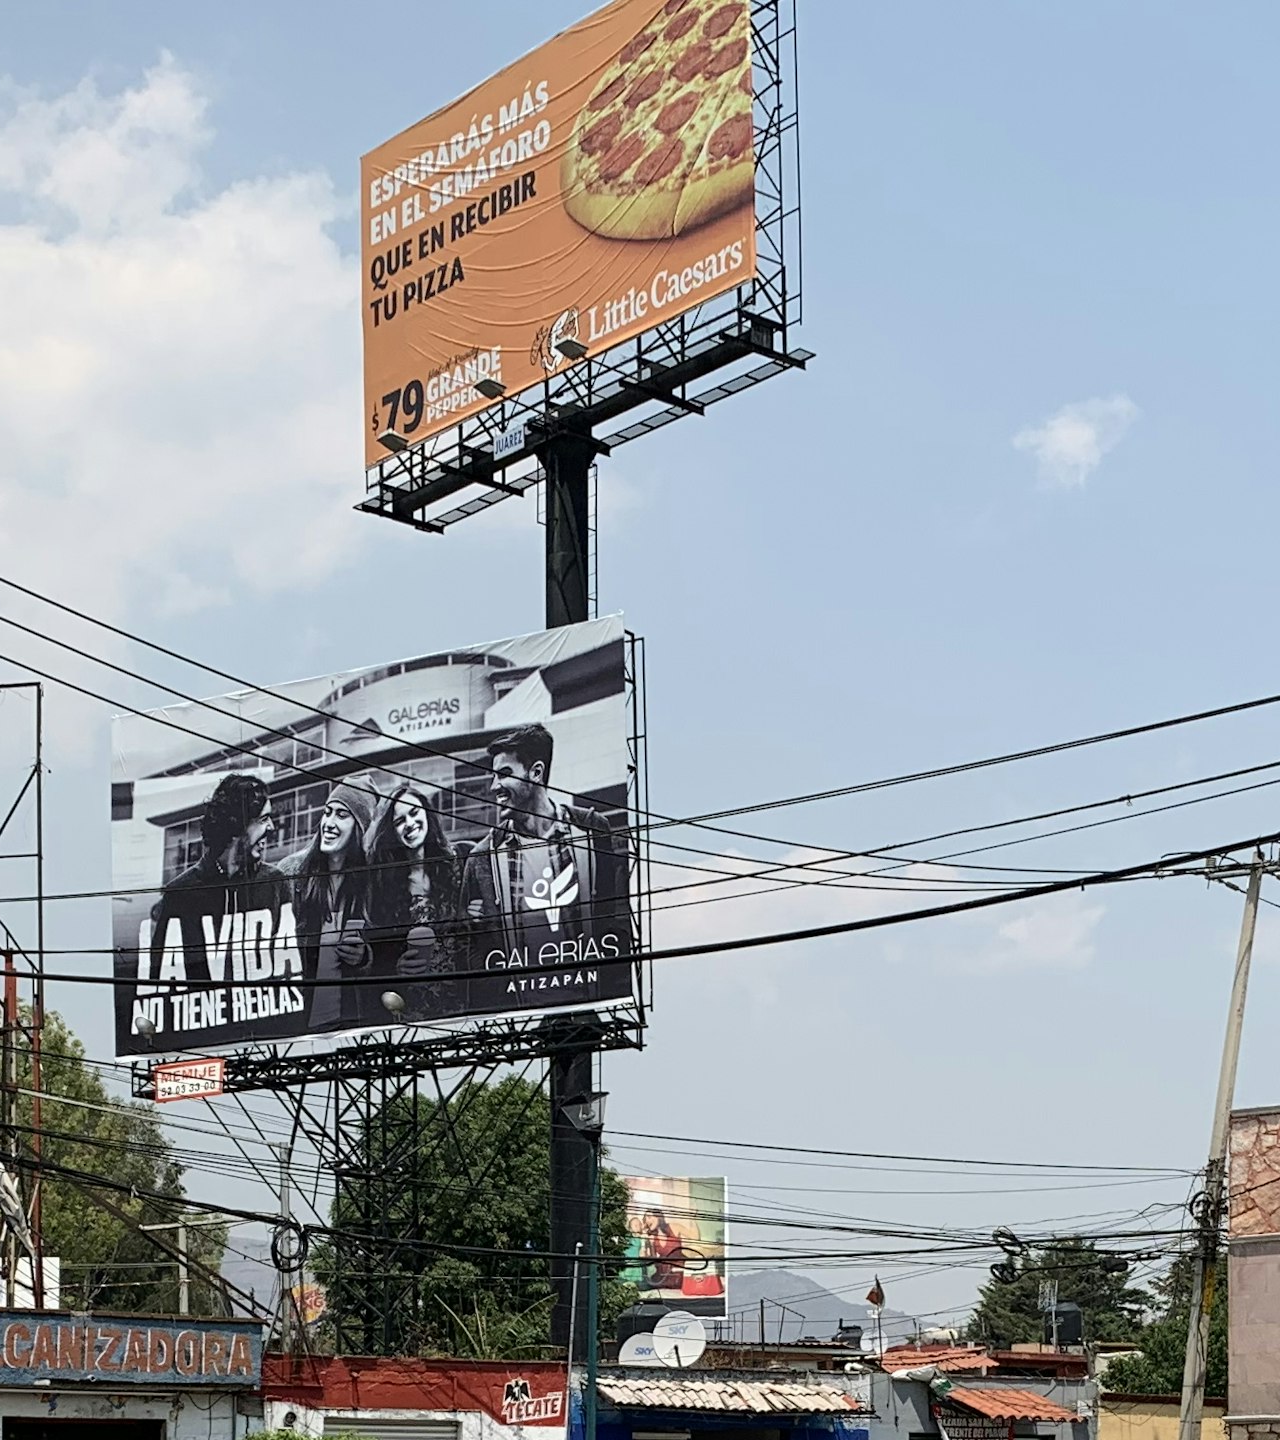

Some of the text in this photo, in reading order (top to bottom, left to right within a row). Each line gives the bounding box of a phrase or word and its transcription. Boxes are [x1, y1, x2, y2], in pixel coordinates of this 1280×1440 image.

[370, 79, 549, 208] ESPERARÁS MÁS
[370, 119, 551, 246] EN EL SEMÁFORO
[370, 170, 537, 290] QUE EN RECIBIR
[370, 256, 465, 328] TU PIZZA
[588, 239, 744, 343] Little Caesars
[426, 344, 502, 403] GRANDE
[494, 430, 524, 455] JUAREZ
[136, 902, 304, 996] LA VIDA
[131, 976, 305, 1035] NO TIENE REGLAS
[507, 970, 598, 993] ATIZAPÁN
[634, 1346, 654, 1356] SKY
[668, 1326, 689, 1335] SKY
[505, 1398, 560, 1419] TECATE
